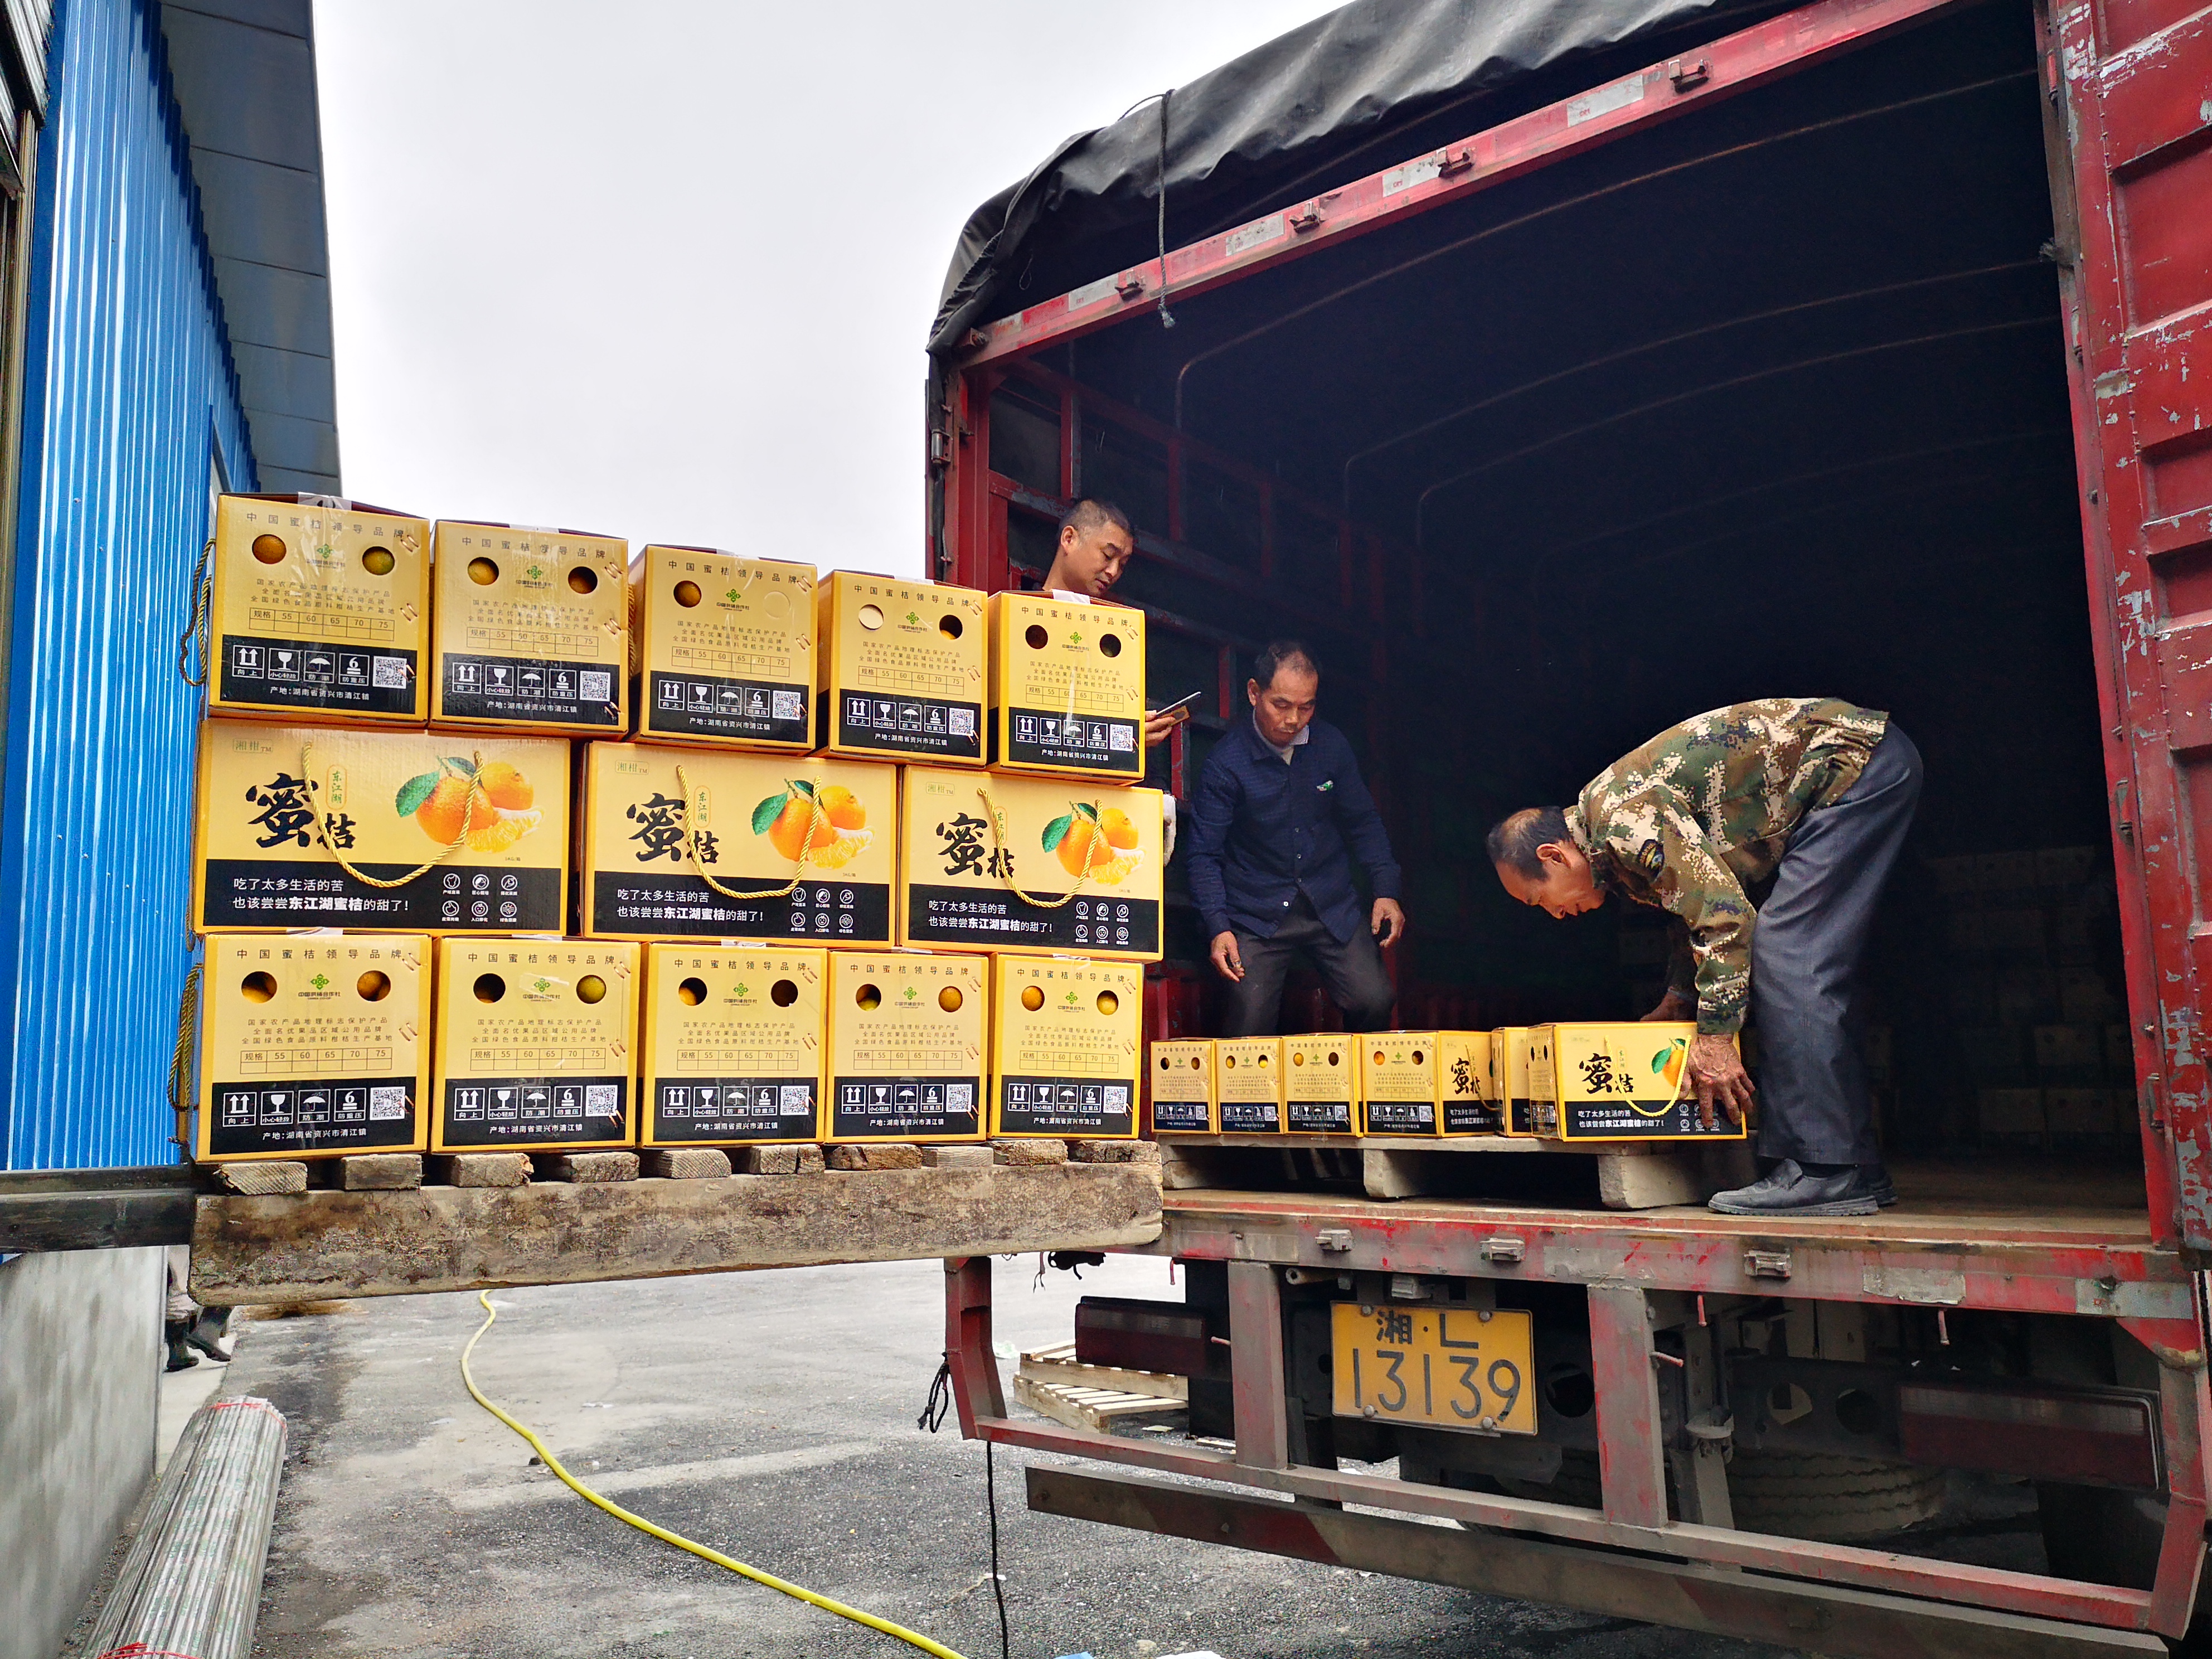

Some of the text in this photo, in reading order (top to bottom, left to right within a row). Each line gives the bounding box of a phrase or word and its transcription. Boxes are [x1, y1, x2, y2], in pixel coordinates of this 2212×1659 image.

[246, 511, 404, 539] 中国蜜桔领导品牌
[668, 559, 797, 584] 中国蜜桔领导品牌
[854, 584, 969, 608] 中国蜜桔领导品牌
[253, 609, 271, 619] 规格
[282, 612, 293, 620] 55
[1021, 605, 1128, 627] 中国蜜桔领导品牌
[470, 629, 486, 637] 规格
[675, 648, 690, 657] 规格
[861, 667, 874, 676] 规格
[697, 792, 707, 822] 东江湖
[234, 877, 344, 892] 吃了太多生活的苦
[617, 889, 710, 903] 吃了太多生活的苦
[929, 900, 1007, 915] 吃了太多生活的苦
[236, 948, 402, 959] 中国蜜桔领导品牌
[467, 952, 615, 965] 中国蜜桔领导品牌
[674, 958, 806, 972] 中国蜜桔领导品牌
[850, 963, 968, 976] 中国蜜桔领导品牌
[1017, 967, 1125, 983] 中国蜜桔领导品牌
[244, 1052, 263, 1061] 规格
[474, 1050, 491, 1059] 规格
[1353, 1348, 1521, 1422] 13139
